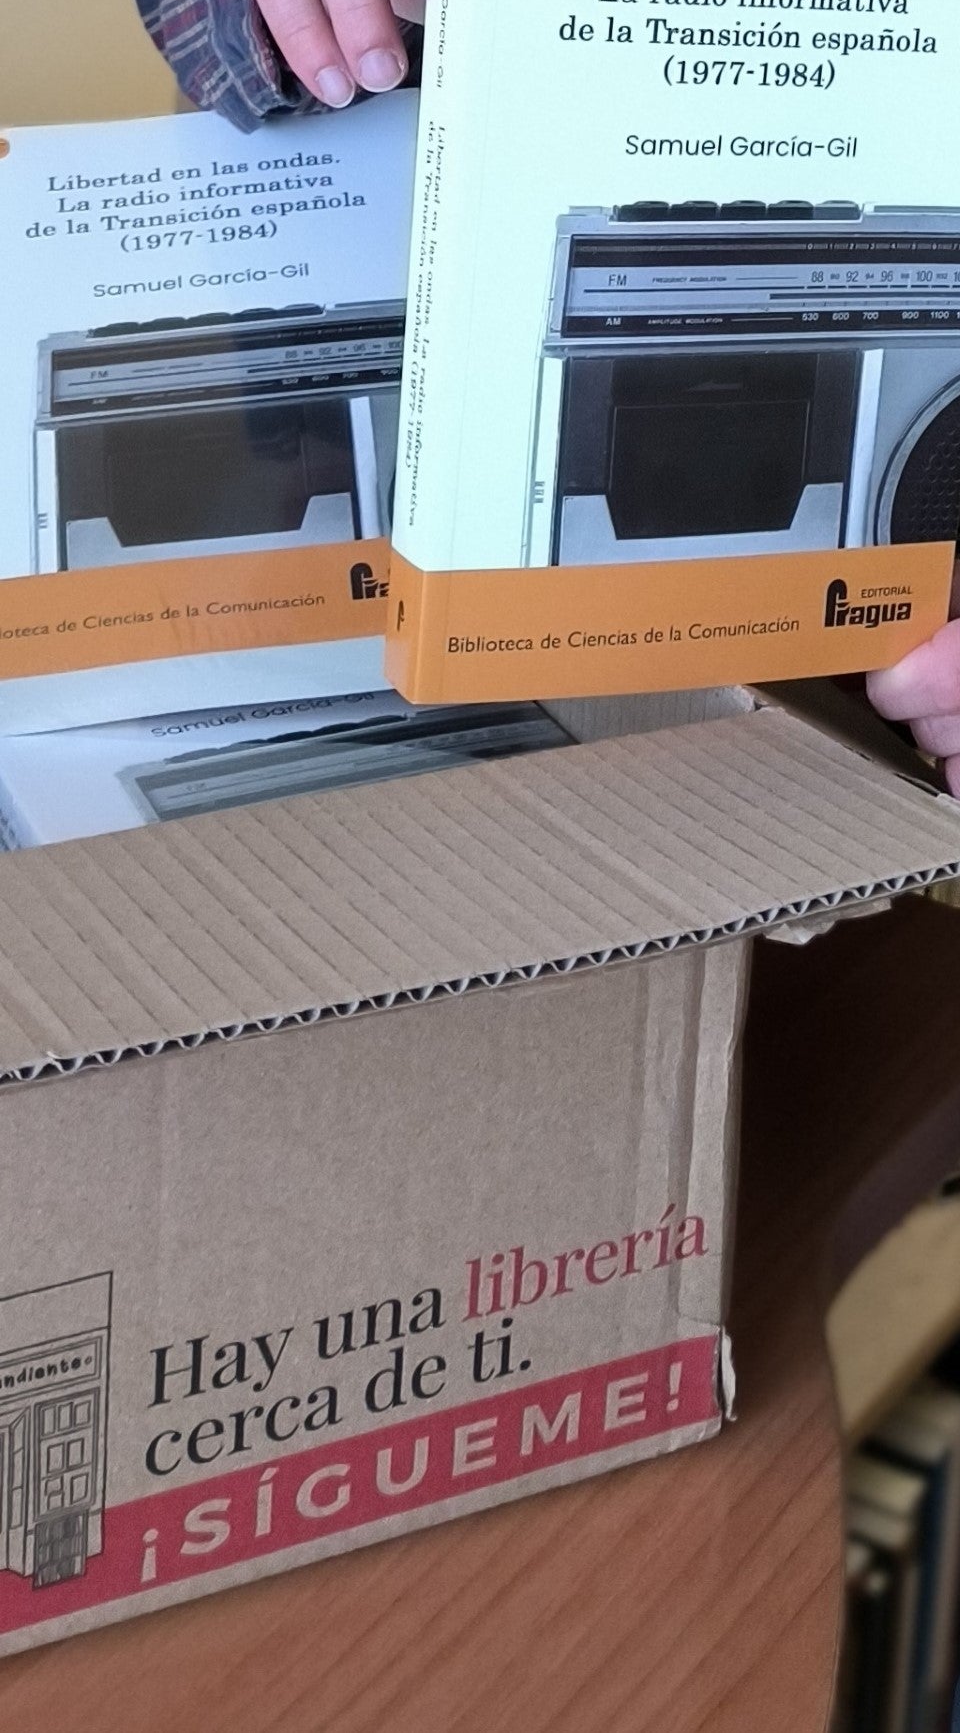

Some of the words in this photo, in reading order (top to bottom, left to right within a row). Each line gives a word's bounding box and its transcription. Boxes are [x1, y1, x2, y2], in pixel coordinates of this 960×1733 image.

[558, 15, 594, 42] de
[606, 17, 634, 44] la
[646, 18, 801, 49] Transición
[811, 28, 938, 56] española
[663, 56, 836, 91] (1977-1984)
[625, 134, 722, 157] Samuel
[730, 135, 858, 158] García-Gil
[48, 168, 161, 193] Libertad
[172, 165, 201, 181] en
[212, 160, 249, 177] las
[257, 152, 341, 172] ondas.
[58, 196, 90, 213] La
[102, 190, 170, 210] radio
[180, 174, 334, 201] informativa
[26, 222, 56, 239] de
[66, 218, 90, 236] la
[100, 204, 241, 232] Transición
[251, 192, 366, 216] española
[120, 221, 278, 253] (1977-1984)
[93, 276, 183, 298] Samuel
[190, 263, 310, 288] García-Gil
[608, 274, 627, 286] FM
[811, 271, 824, 282] 88
[846, 270, 858, 282] 92
[880, 270, 894, 282] 96
[916, 270, 933, 282] 100
[605, 317, 622, 326] AM
[832, 312, 849, 321] 600
[862, 311, 879, 320] 700
[930, 310, 950, 319] 1100
[861, 585, 913, 598] EDITORIAL
[0, 625, 49, 639] oteca
[57, 619, 77, 633] de
[83, 611, 154, 630] Ciencias
[160, 607, 181, 621] de
[185, 604, 200, 618] la
[206, 593, 326, 616] Comunicación
[448, 636, 534, 655] Biblioteca
[541, 632, 562, 649] de
[567, 628, 638, 648] Ciencias
[644, 626, 665, 643] de
[669, 625, 682, 642] la
[688, 616, 800, 640] Comunicación
[150, 712, 247, 737] Samuel
[147, 1323, 294, 1408] Hay
[313, 1286, 447, 1360] una
[462, 1203, 709, 1322] librería
[145, 1384, 343, 1476] cerca
[365, 1347, 447, 1414] de
[469, 1318, 532, 1381] ti.
[139, 1361, 684, 1583] ¡SÍGUEME!
